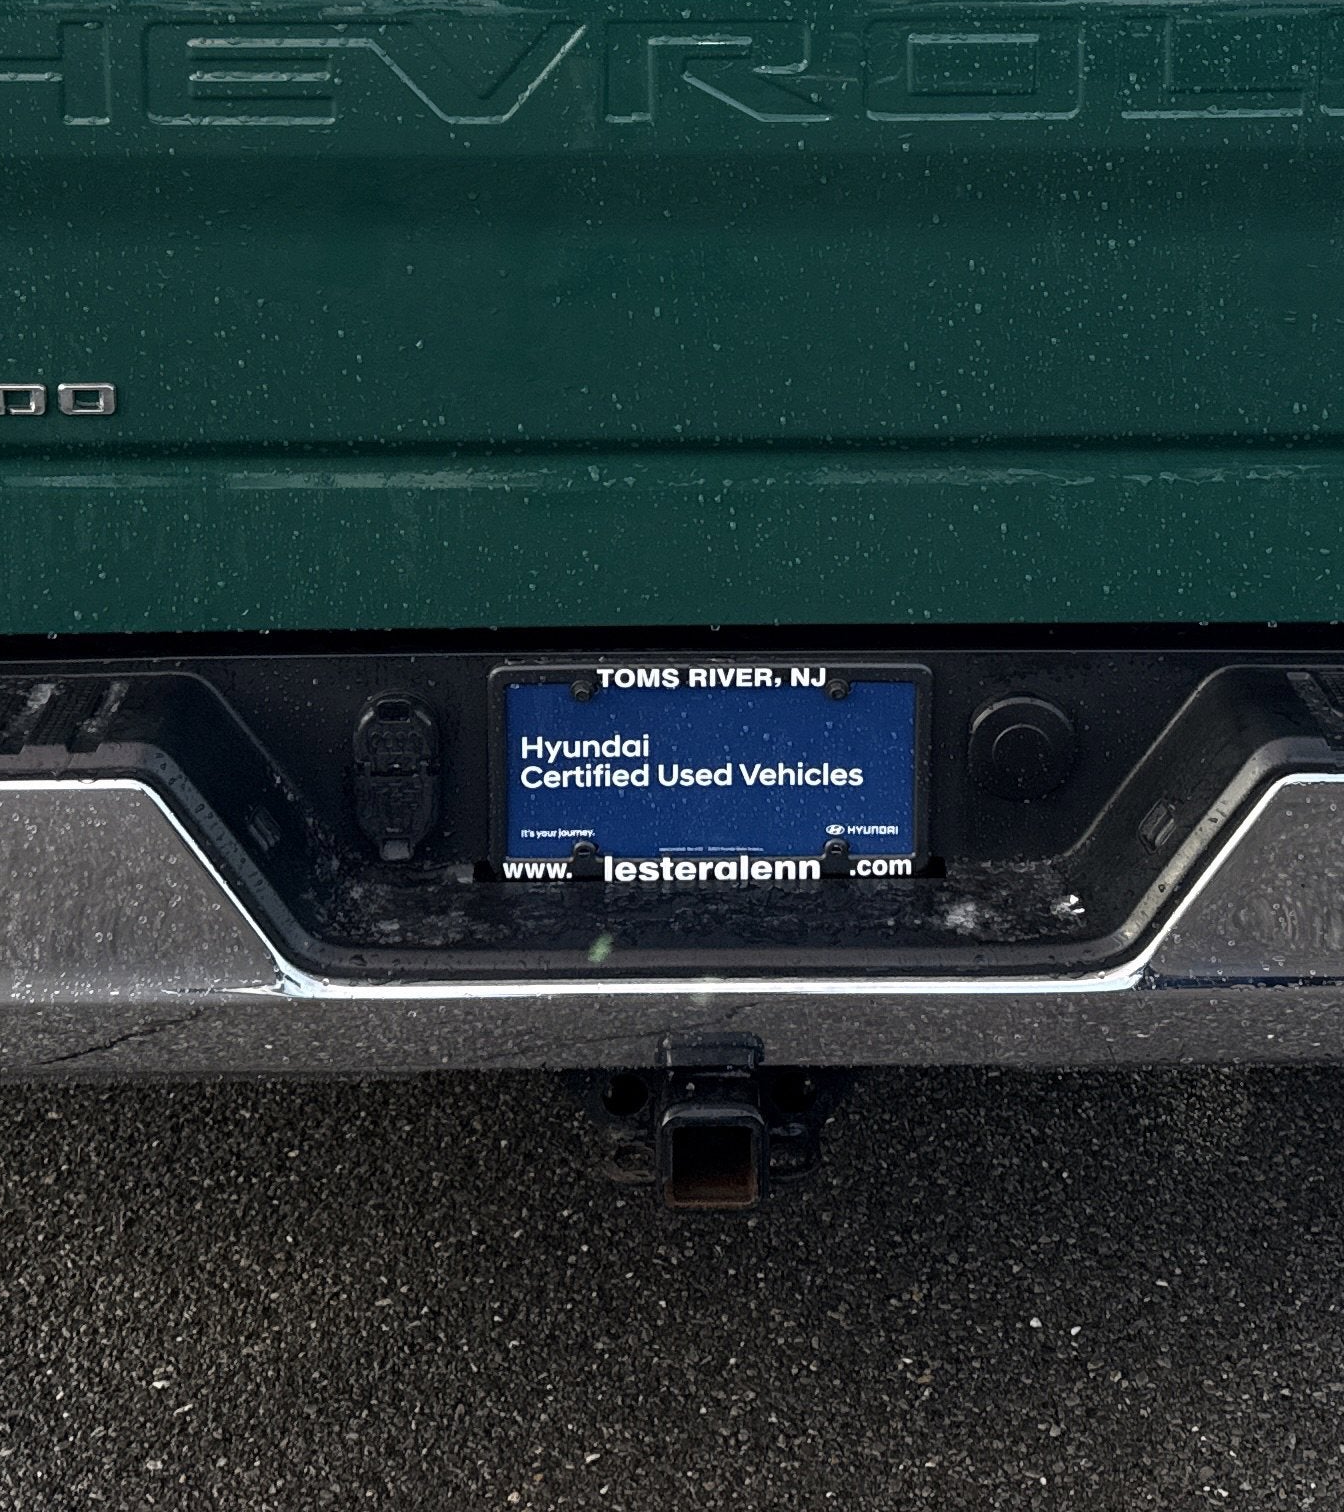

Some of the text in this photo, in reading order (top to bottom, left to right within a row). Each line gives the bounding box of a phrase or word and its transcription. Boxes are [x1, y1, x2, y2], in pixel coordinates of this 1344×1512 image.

[596, 668, 826, 688] TOMS RIVER, NJ
[521, 734, 649, 763] Hyundai
[520, 762, 864, 788] Certified Used Vehicles
[536, 830, 557, 839] your
[847, 825, 899, 835] HYUNDAI
[503, 862, 573, 879] www.
[849, 858, 913, 877] .com
